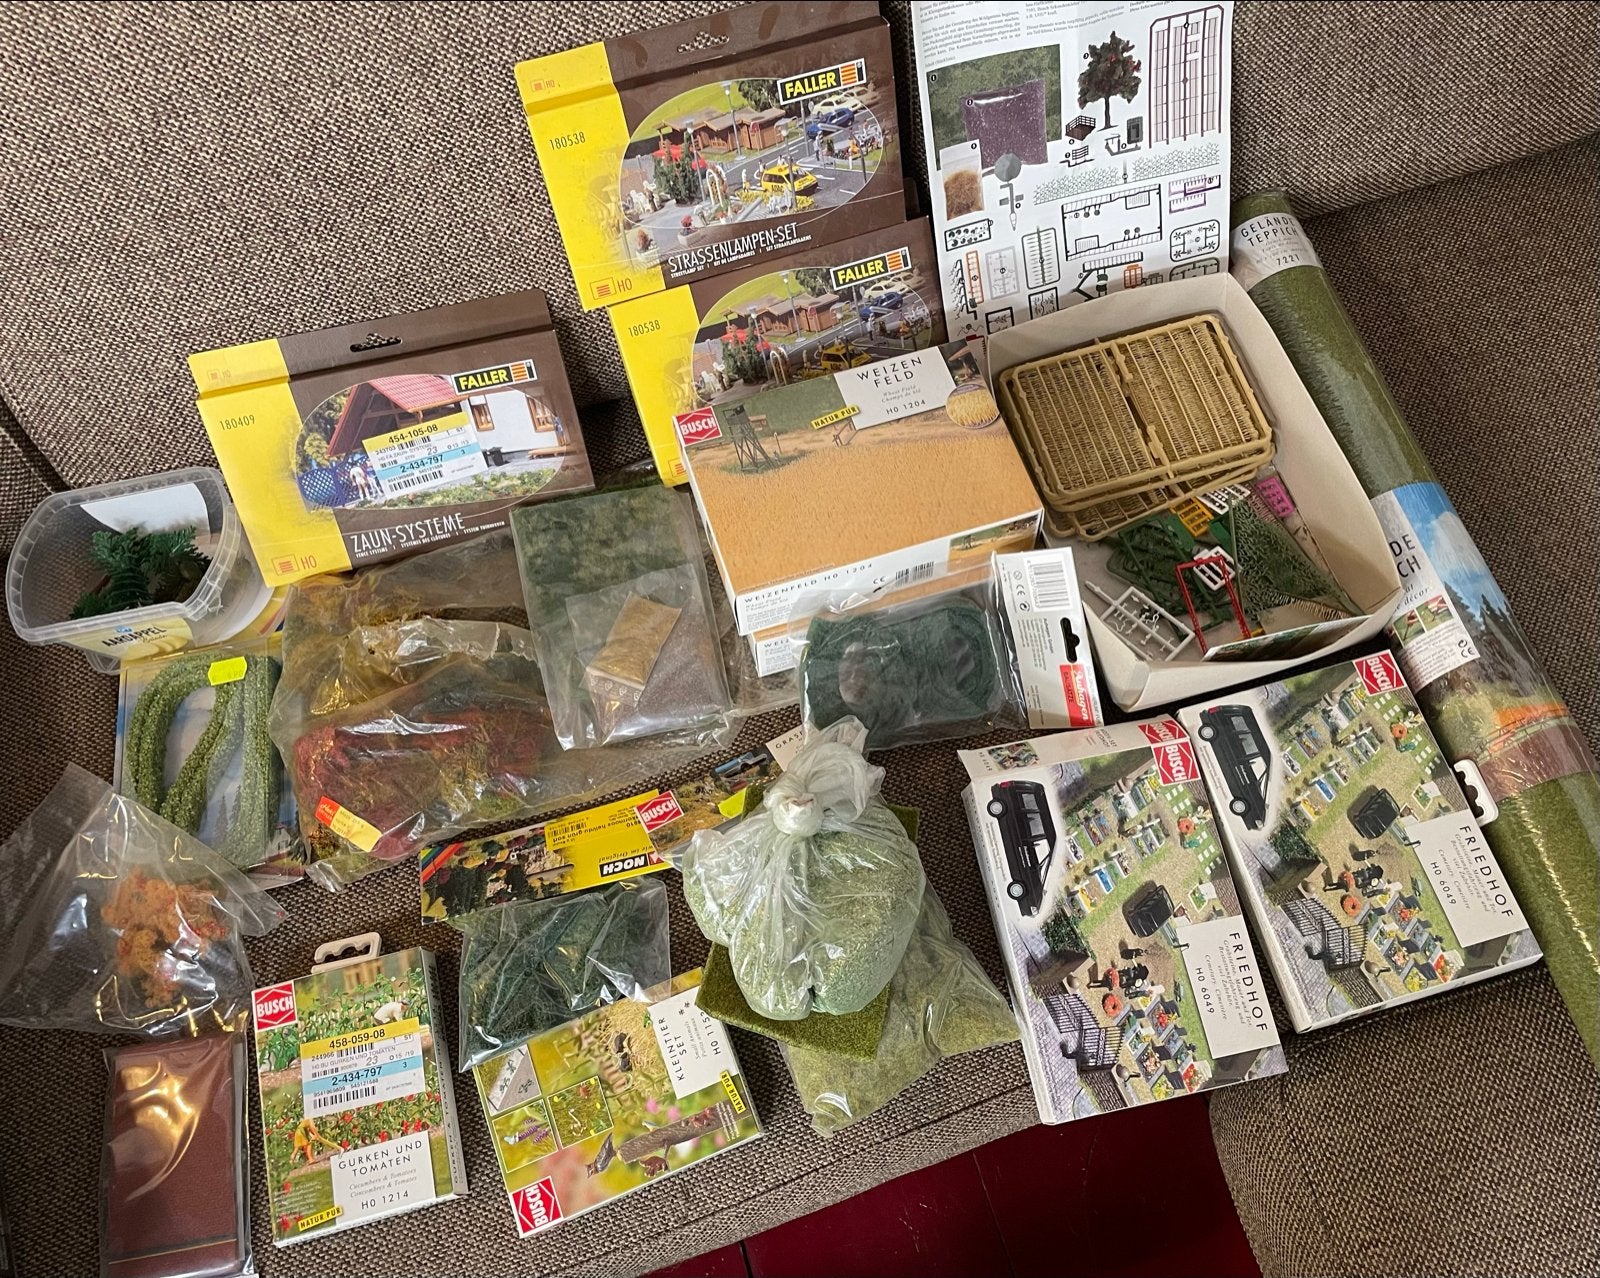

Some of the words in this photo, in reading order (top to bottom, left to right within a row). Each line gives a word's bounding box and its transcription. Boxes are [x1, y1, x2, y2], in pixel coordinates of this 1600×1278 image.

[785, 72, 836, 98] FALLER
[550, 132, 585, 150] 180538
[668, 222, 797, 272] STRASSENLAMPEN-SET
[1276, 254, 1300, 265] 7221
[837, 260, 884, 284] FALLER
[628, 320, 660, 337] 180538
[857, 357, 922, 380] WEIZEN
[874, 370, 914, 388] FELD
[459, 369, 509, 390] FALLER
[903, 400, 926, 410] 1204
[220, 415, 255, 431] 180409
[680, 418, 716, 436] BUSCH
[814, 414, 839, 428] NATUR
[841, 407, 857, 417] PUR
[388, 424, 438, 444] 454-105-08
[400, 454, 444, 473] 2-434-797
[350, 512, 465, 553] ZAUN-SYSTEME
[744, 579, 817, 603] WEIZENFELD
[102, 626, 167, 647] AARDAPPEL
[1366, 656, 1394, 691] BUSCH
[1071, 669, 1091, 721] Auhagen
[1165, 745, 1188, 781] BUSCH
[641, 799, 677, 823] BUSCH
[598, 851, 628, 863] Original
[602, 857, 645, 875] NOCH
[1460, 826, 1513, 917] FRIEDHOF
[1440, 881, 1456, 904] 6049
[1229, 932, 1268, 1031] FRIEDHOF
[256, 996, 294, 1019] BUSCH
[1201, 987, 1215, 1014] 6049
[329, 1029, 385, 1049] 458-059-08
[659, 1017, 685, 1081] KLEINTIER
[674, 1035, 687, 1056] SET
[311, 1053, 335, 1062] 244966
[365, 1055, 378, 1066] 23
[332, 1066, 383, 1086] 2-434-797
[721, 1073, 734, 1086] PUR
[729, 1088, 743, 1112] NATUR
[338, 1149, 389, 1170] GURKEN
[396, 1140, 422, 1153] UND
[352, 1155, 411, 1177] TOMATEN
[382, 1190, 409, 1203] 1214
[525, 1184, 549, 1227] BUSCH
[300, 1214, 324, 1229] NATUR
[326, 1207, 340, 1218] PUR
